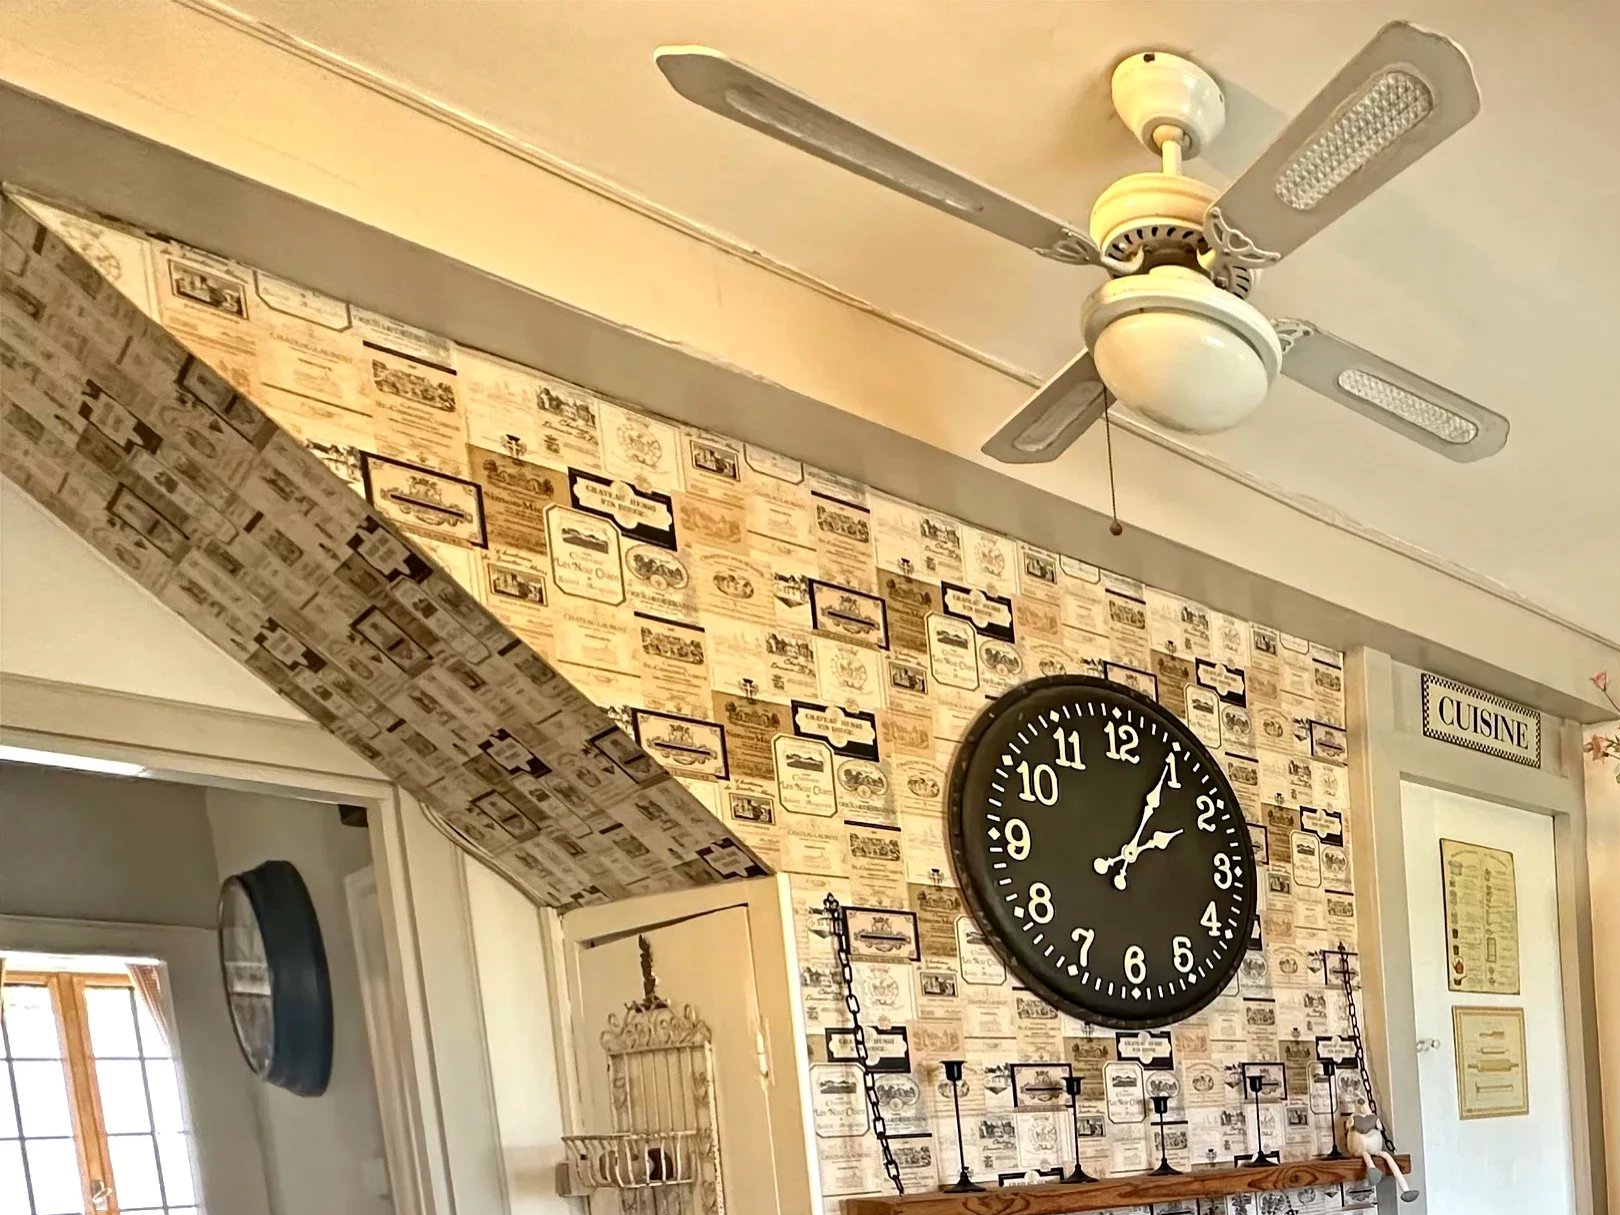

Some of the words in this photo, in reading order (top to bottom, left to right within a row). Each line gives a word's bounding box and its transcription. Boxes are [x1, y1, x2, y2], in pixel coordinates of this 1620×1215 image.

[1438, 696, 1529, 750] CUISINE
[1053, 727, 1086, 771] 11
[1104, 721, 1140, 765] 12
[1017, 761, 1058, 806] 10
[1164, 751, 1182, 789] 1
[1196, 795, 1217, 832] 2
[1005, 819, 1031, 860] 9
[1213, 853, 1232, 889] 3
[1029, 883, 1054, 924] 8
[1200, 901, 1221, 936] 4
[1072, 928, 1095, 967] 7
[1125, 946, 1146, 984] 6
[1173, 936, 1194, 972] 5
